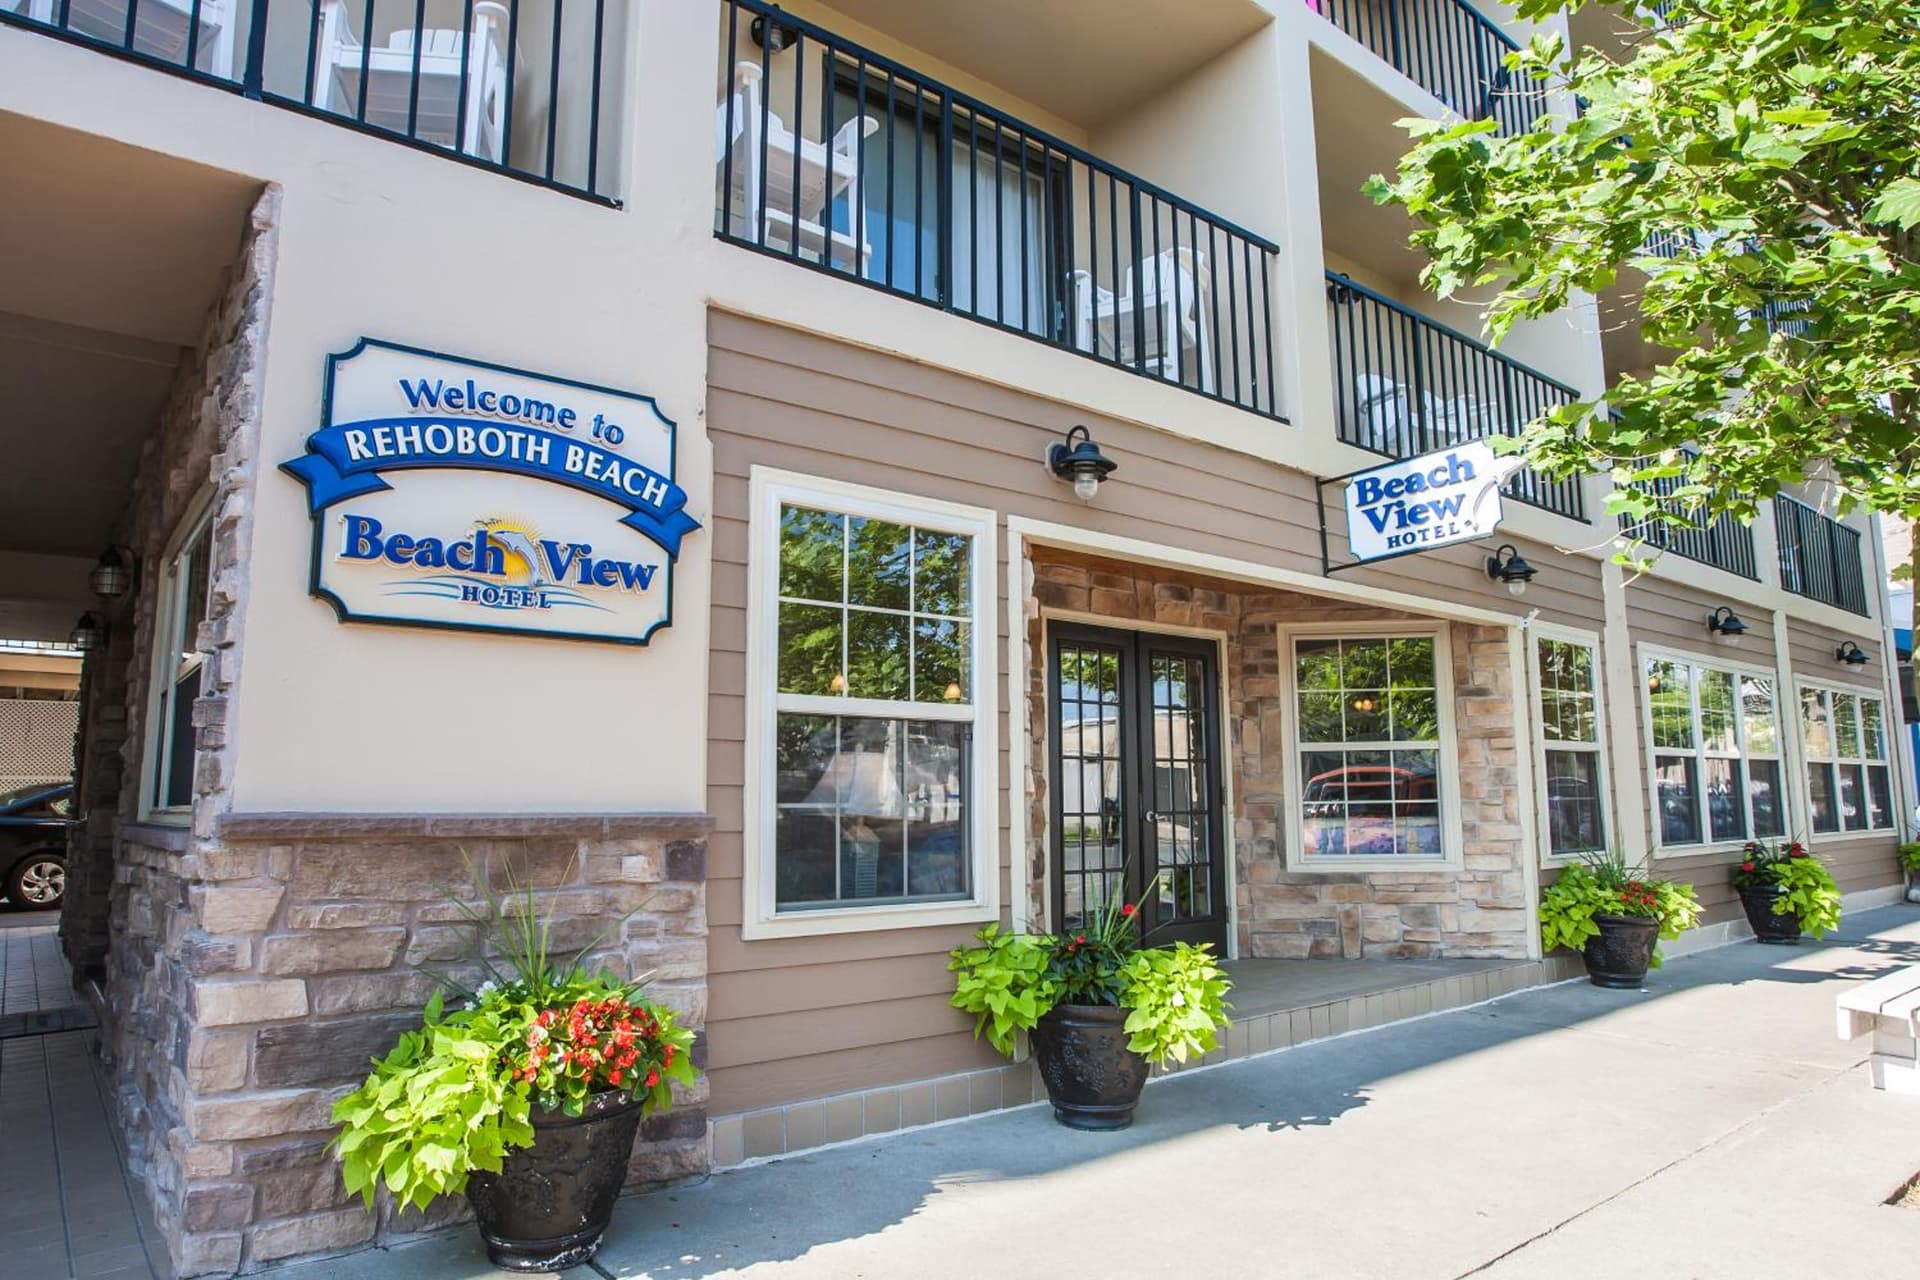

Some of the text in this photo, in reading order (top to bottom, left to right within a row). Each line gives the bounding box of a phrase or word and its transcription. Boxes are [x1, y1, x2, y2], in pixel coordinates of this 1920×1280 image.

[399, 378, 625, 445] Welcome to
[344, 424, 669, 508] REHOBOTH BEACH
[1354, 453, 1477, 507] Beach
[1362, 494, 1467, 534] View
[1388, 523, 1461, 549] HOTEL
[339, 514, 658, 591] Beach View
[460, 585, 551, 609] HOTEL
